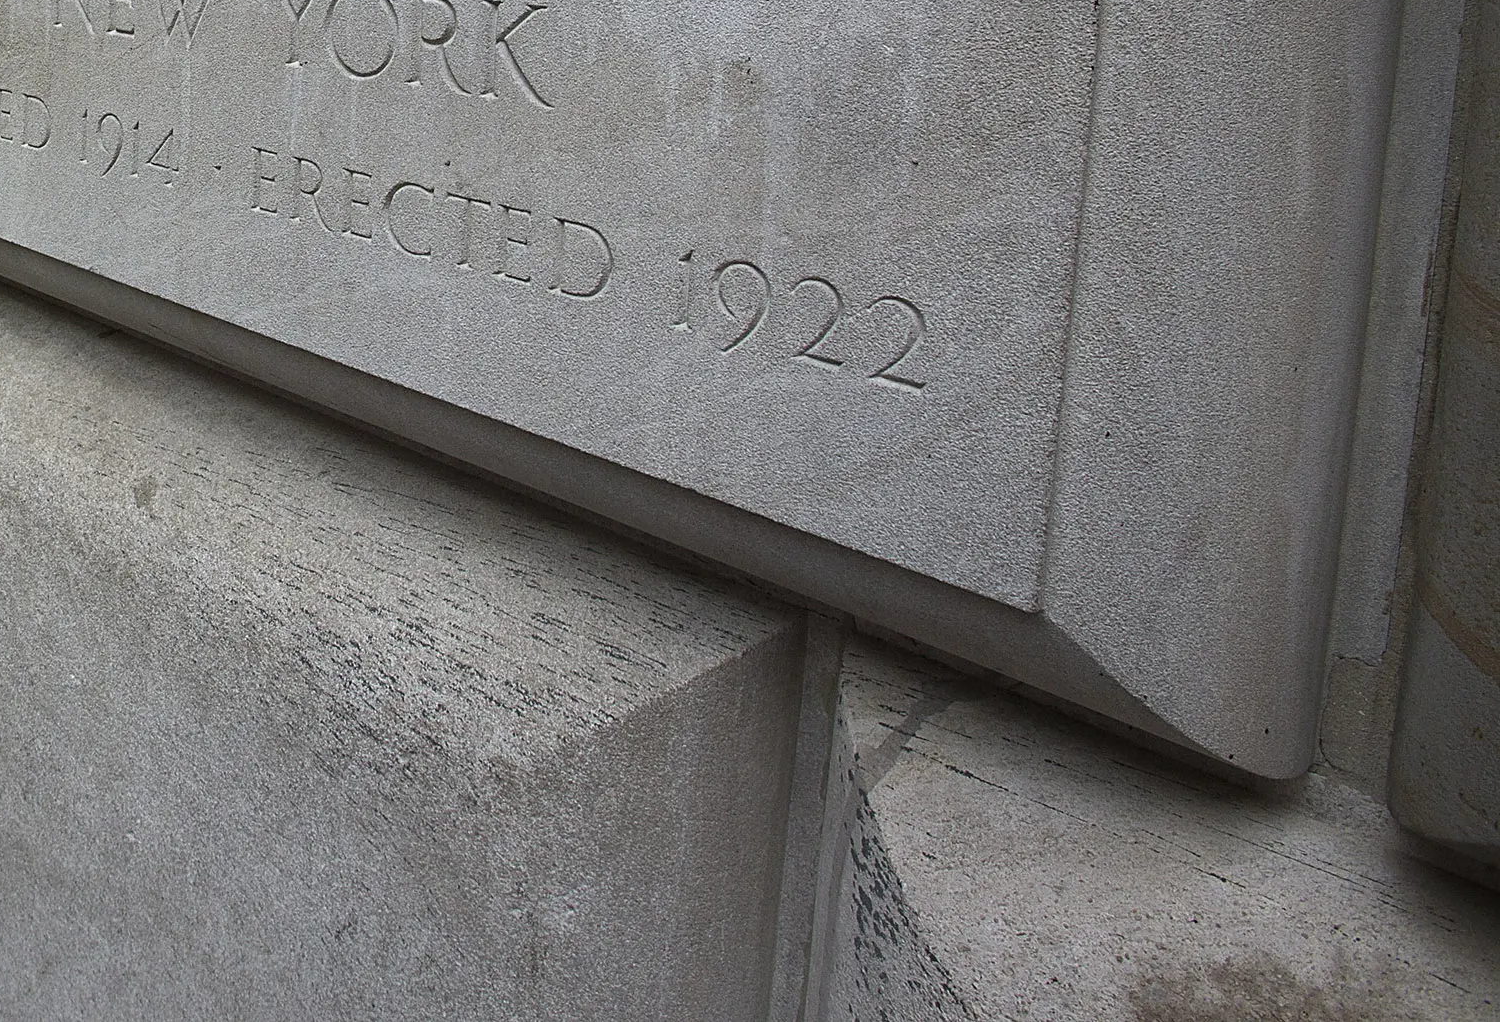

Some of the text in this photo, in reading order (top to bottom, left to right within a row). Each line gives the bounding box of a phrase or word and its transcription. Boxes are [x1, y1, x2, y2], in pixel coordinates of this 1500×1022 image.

[79, 108, 181, 185] 1914
[251, 145, 615, 298] ERECTED
[670, 249, 927, 390] 1922
